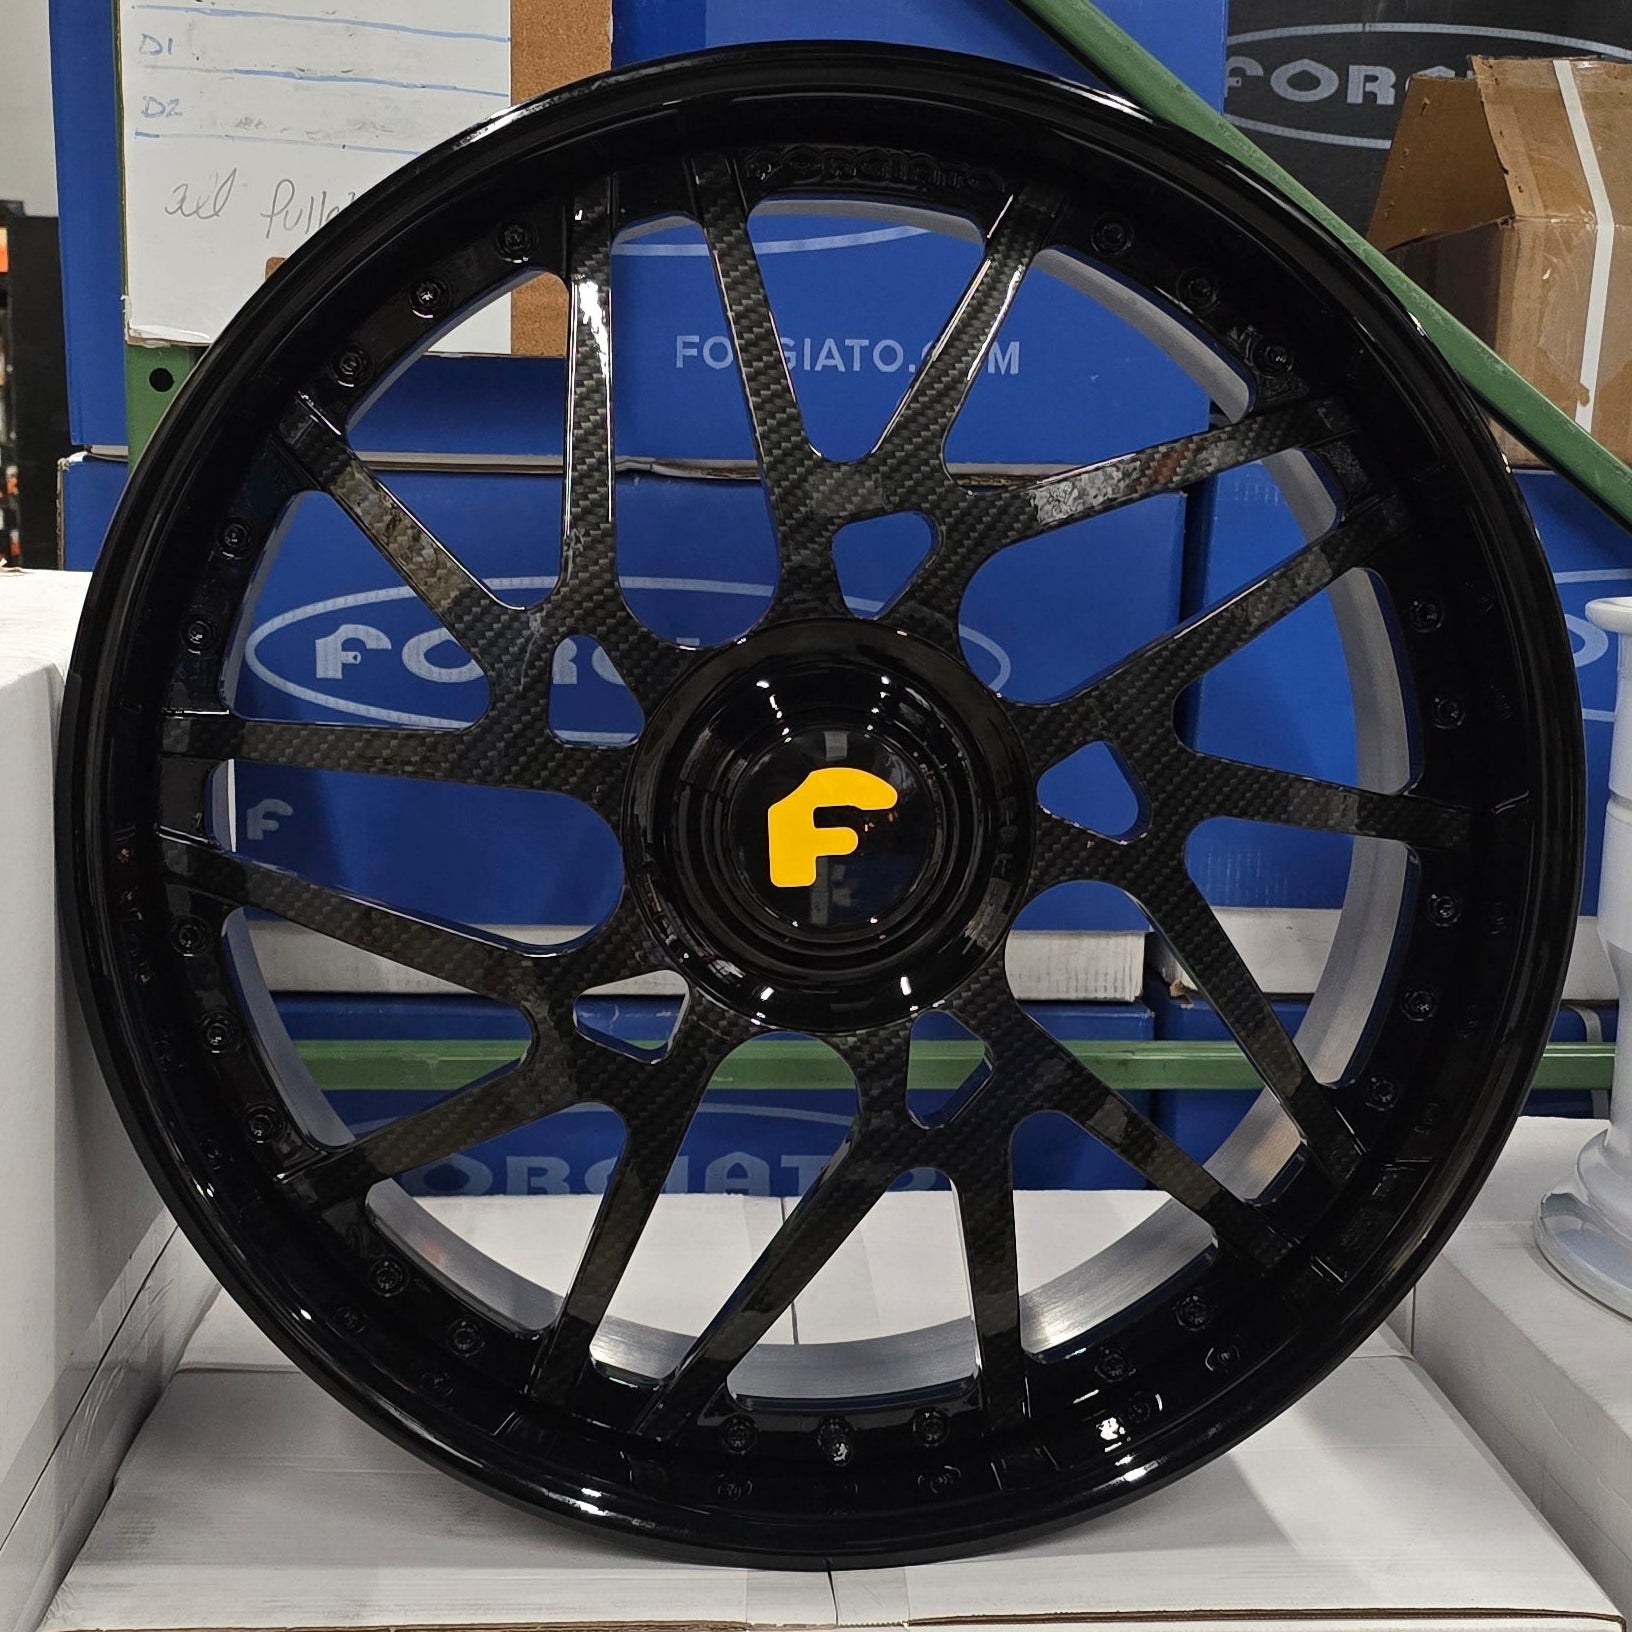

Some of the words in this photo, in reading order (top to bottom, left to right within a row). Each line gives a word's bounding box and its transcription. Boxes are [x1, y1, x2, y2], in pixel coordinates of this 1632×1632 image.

[139, 34, 173, 55] D1
[141, 96, 182, 118] D2
[247, 799, 293, 841] F
[767, 766, 898, 888] F
